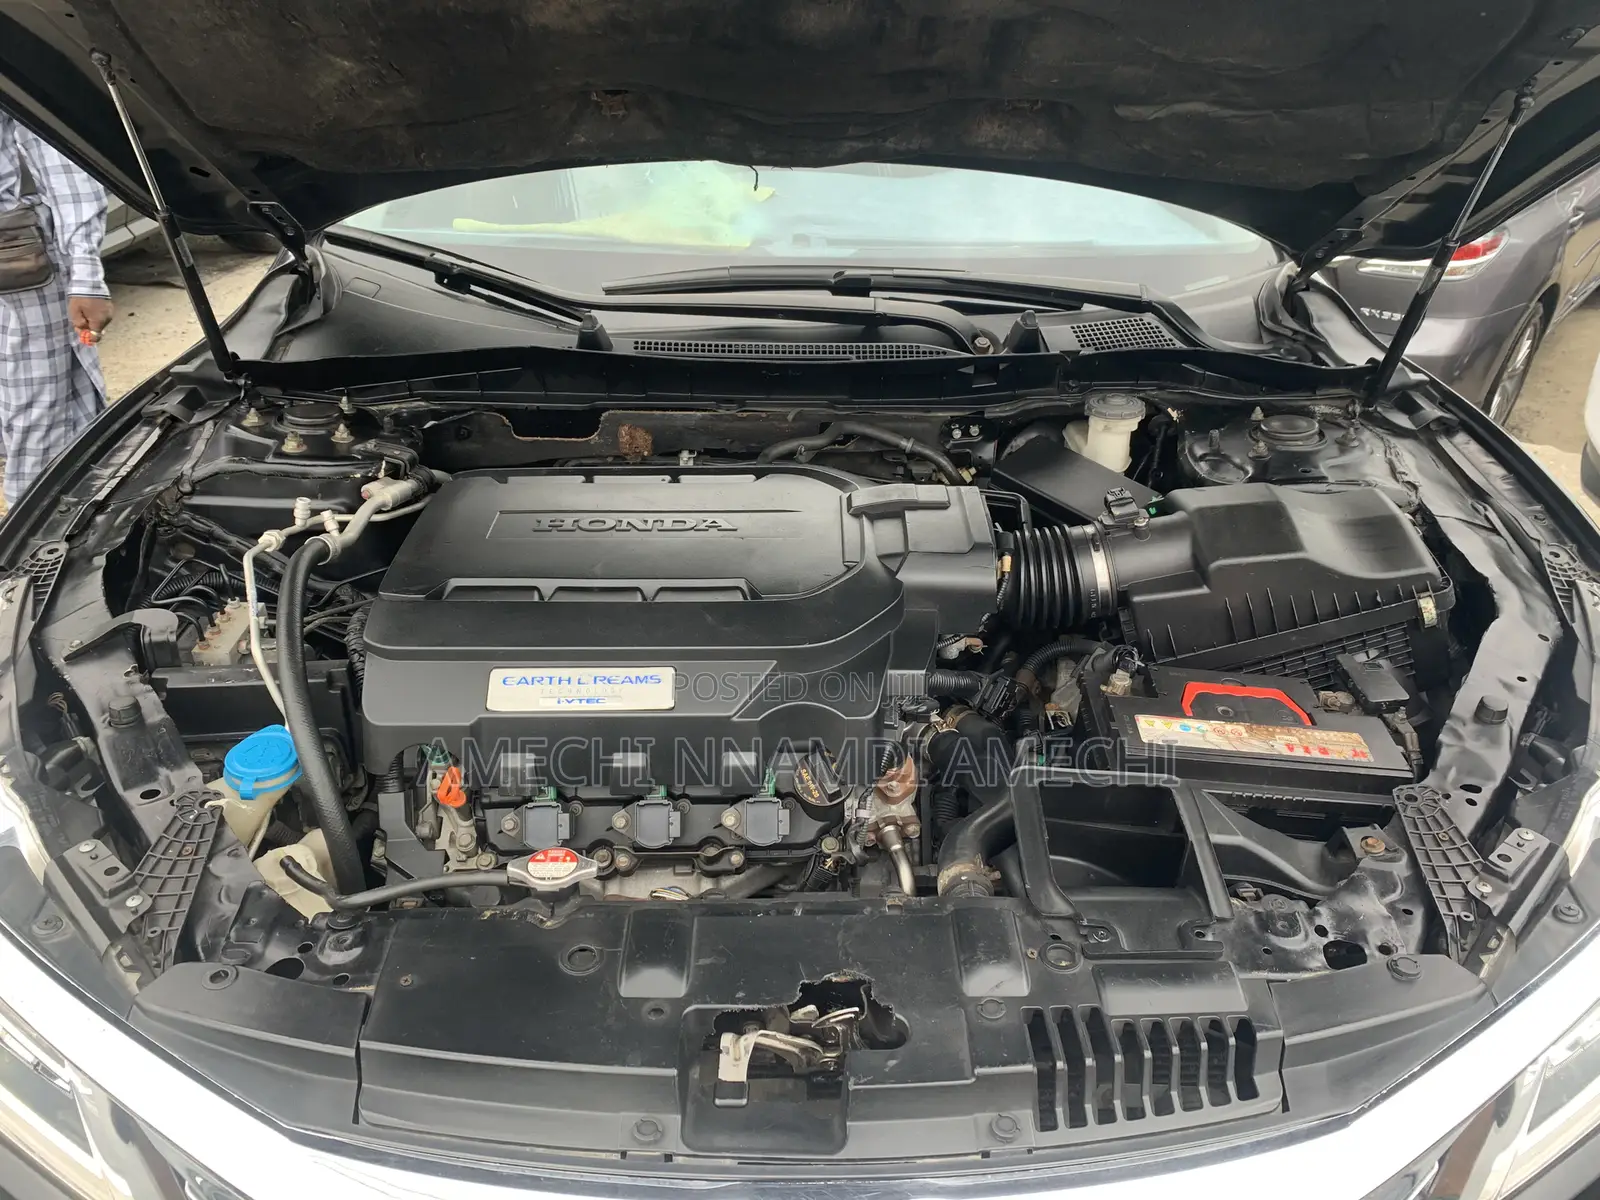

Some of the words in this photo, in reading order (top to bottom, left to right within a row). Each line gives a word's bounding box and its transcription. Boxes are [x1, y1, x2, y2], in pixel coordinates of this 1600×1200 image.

[1360, 307, 1405, 321] RX35
[532, 517, 738, 532] HONDA
[502, 675, 572, 686] EARTH
